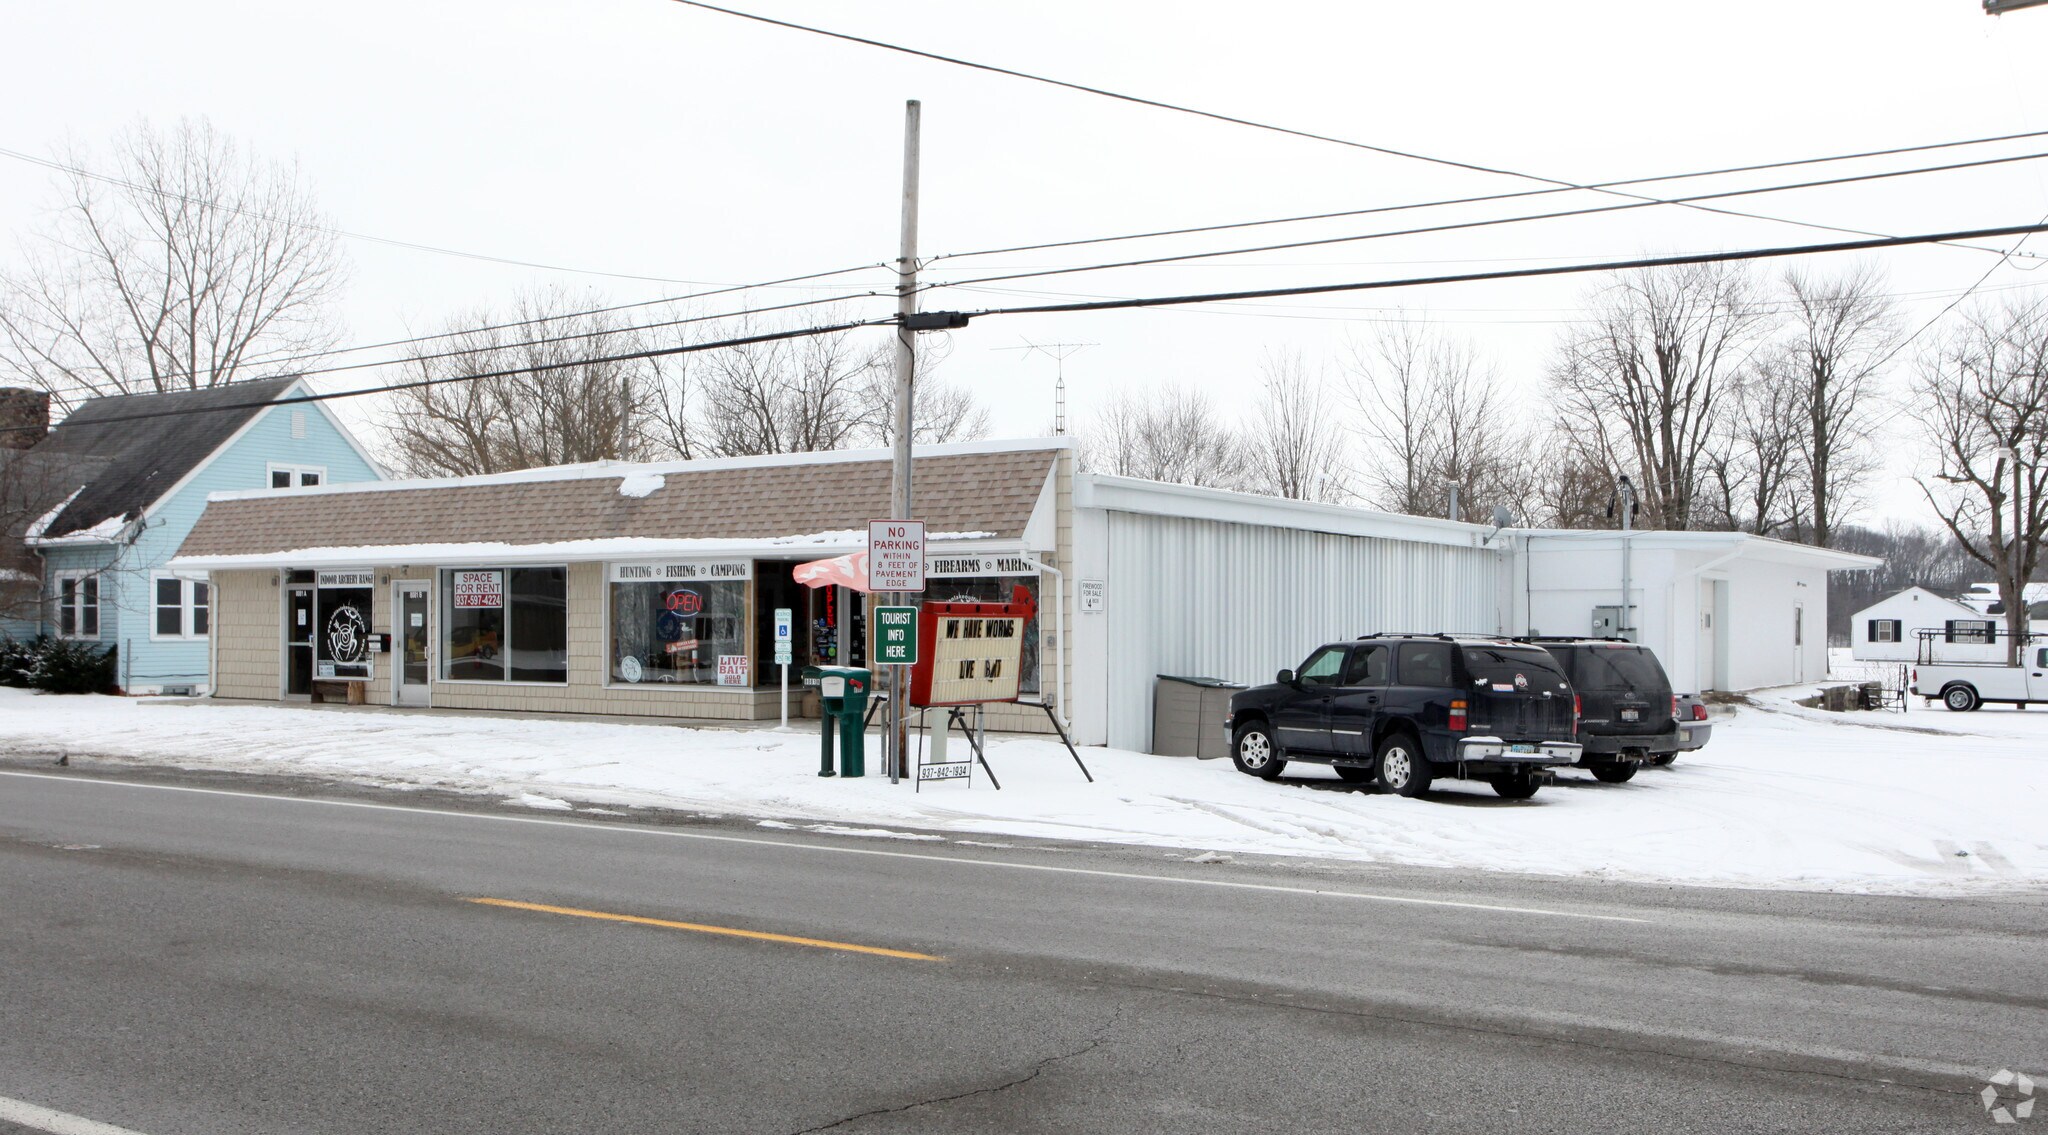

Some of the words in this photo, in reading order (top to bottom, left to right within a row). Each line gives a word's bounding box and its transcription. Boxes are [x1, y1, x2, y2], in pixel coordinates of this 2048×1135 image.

[888, 526, 905, 538] NO
[874, 541, 919, 550] PARKING
[883, 552, 911, 560] WITHIN
[620, 566, 651, 578] HUNTING
[666, 565, 695, 577] FISHING
[711, 564, 746, 577] CAMPING
[877, 561, 883, 569] 8
[888, 561, 906, 569] FEET
[908, 561, 918, 569] OF
[934, 559, 980, 573] FIREARMS
[320, 574, 337, 585] INDOOR
[338, 574, 358, 584] ARCHERY
[359, 573, 373, 584] RANGE
[463, 573, 492, 583] SPACE
[875, 570, 917, 578] PAVEMENT
[455, 583, 473, 593] FOR
[476, 583, 500, 593] RENT
[886, 579, 907, 587] EDGE
[455, 594, 501, 606] 937-597-4224
[666, 593, 702, 611] OPEN
[881, 612, 911, 625] TOURIST
[887, 629, 904, 641] INFO
[946, 619, 959, 639] WE
[963, 619, 983, 638] HAVE
[986, 619, 1014, 638] WORMS
[886, 645, 906, 658] HERE
[720, 656, 747, 666] LIVE
[719, 665, 747, 675] BAIT
[959, 660, 975, 679] LIVE
[921, 765, 967, 779] 937-842-1934
